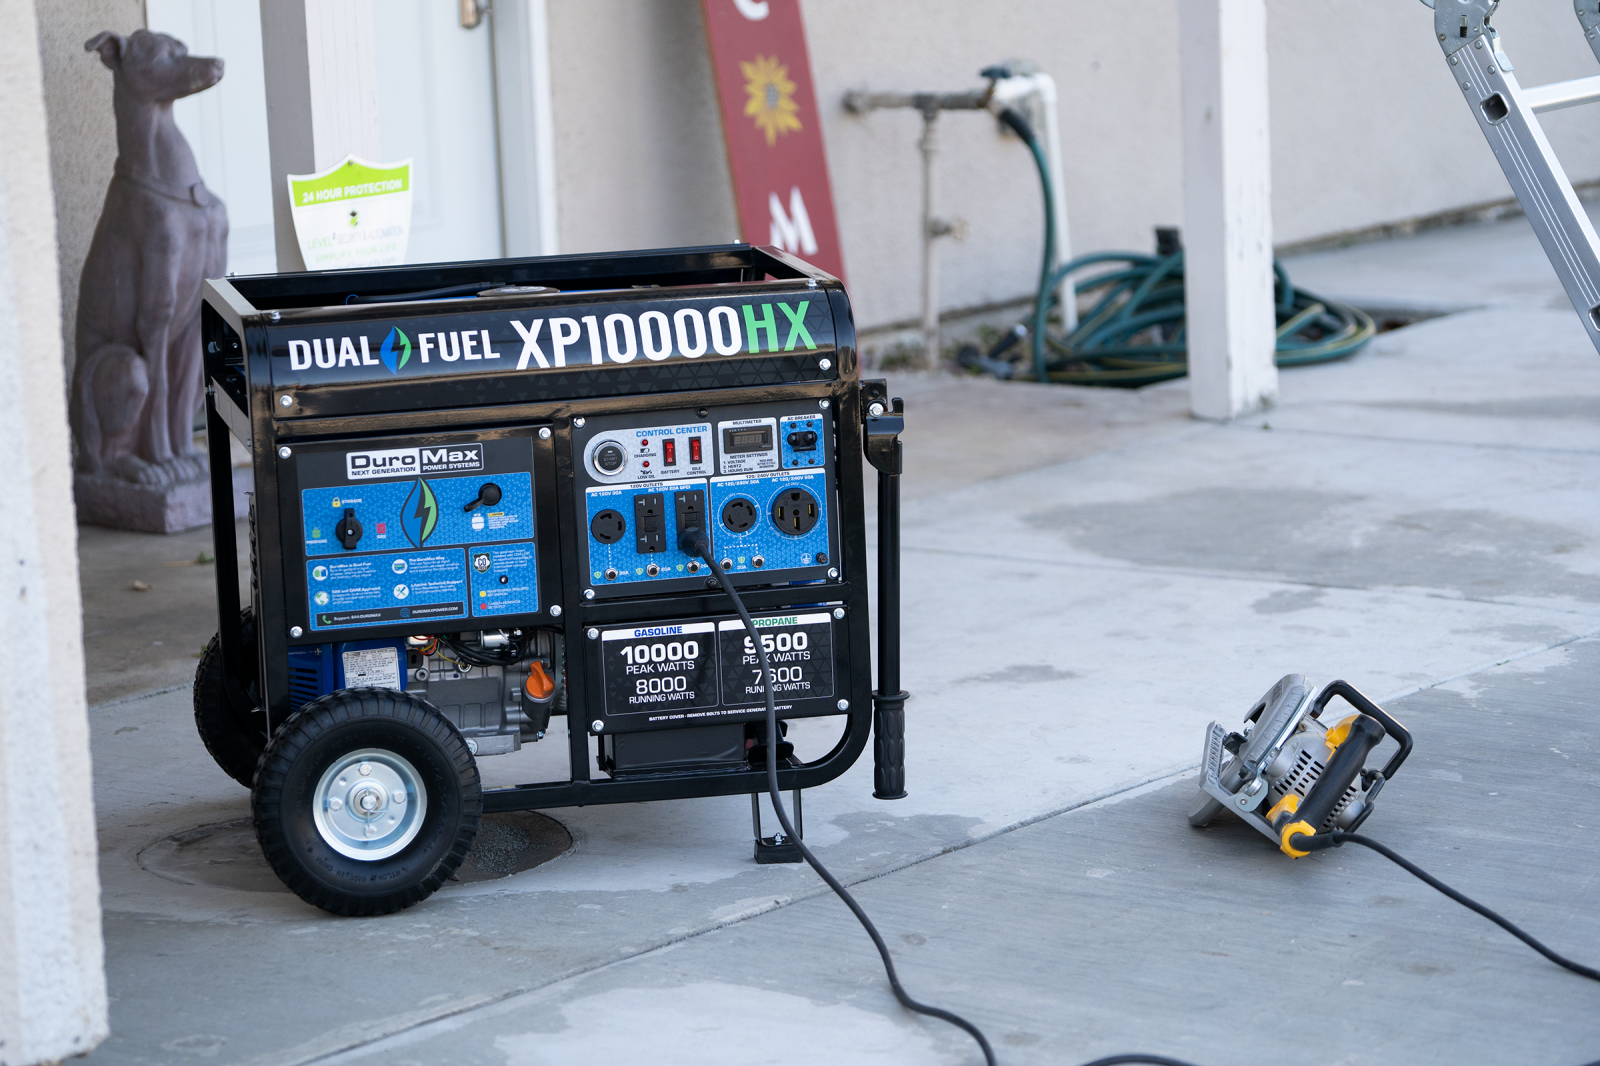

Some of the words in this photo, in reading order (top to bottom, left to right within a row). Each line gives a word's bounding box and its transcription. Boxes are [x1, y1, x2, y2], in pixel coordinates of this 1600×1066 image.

[302, 191, 315, 204] 24
[316, 187, 343, 202] HOUR
[344, 178, 403, 198] PROTECTION
[307, 236, 333, 250] LEVEL
[379, 242, 397, 253] LIFE
[288, 336, 380, 371] DUAL
[418, 329, 501, 363] FUEL
[509, 301, 818, 371] XP10000HX
[636, 430, 674, 438] CONTROL
[675, 425, 708, 435] CENTER
[351, 455, 416, 470] Duro
[421, 449, 479, 464] Max
[422, 463, 448, 471] POWER
[448, 461, 481, 469] SYSTEMS
[371, 467, 416, 475] GENERATION
[752, 616, 798, 627] PROPANE
[634, 626, 683, 638] GASOLINE
[743, 632, 808, 655] 9500
[620, 641, 699, 665] 10000
[772, 650, 811, 662] WATTS
[626, 664, 655, 675] PEAK
[656, 660, 695, 672] WATTS
[635, 676, 687, 695] 8000
[782, 682, 811, 692] WATTS
[629, 693, 666, 704] RUNNING
[666, 691, 695, 701] WATTS
